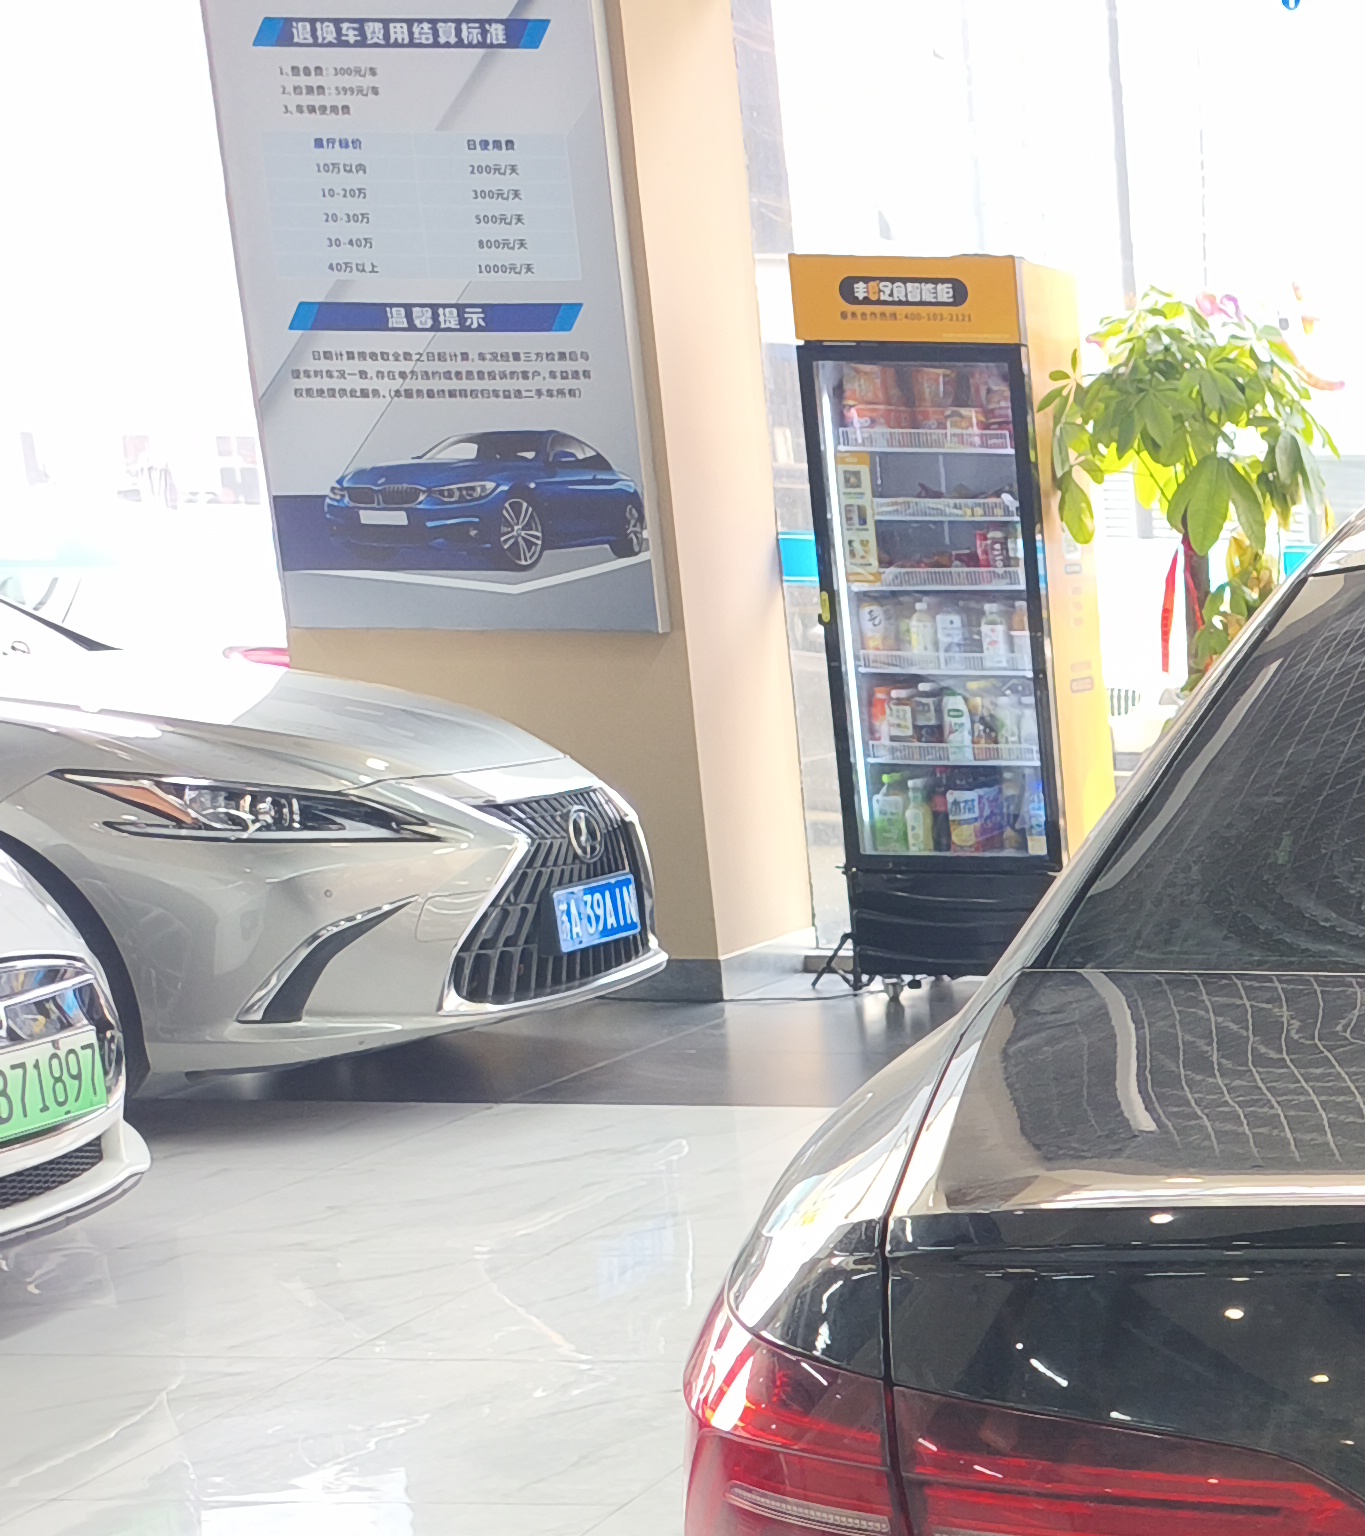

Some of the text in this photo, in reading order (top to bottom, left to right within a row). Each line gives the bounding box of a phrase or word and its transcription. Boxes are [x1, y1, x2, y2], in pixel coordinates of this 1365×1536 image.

[292, 21, 507, 45] 退换车费用结算标准
[466, 139, 515, 151] 日使用费
[316, 162, 367, 174] 10万以内
[469, 164, 520, 176] 200元/天
[321, 187, 367, 199] 10-20万
[472, 189, 522, 201] 300元/天
[323, 212, 370, 224] 20-30万
[475, 214, 525, 226] 500元/天
[326, 237, 373, 249] 30-40万
[478, 238, 528, 251] 800元/天
[328, 261, 379, 274] 40万以上
[478, 263, 535, 275] 1000元/天
[386, 306, 487, 329] 温馨提示
